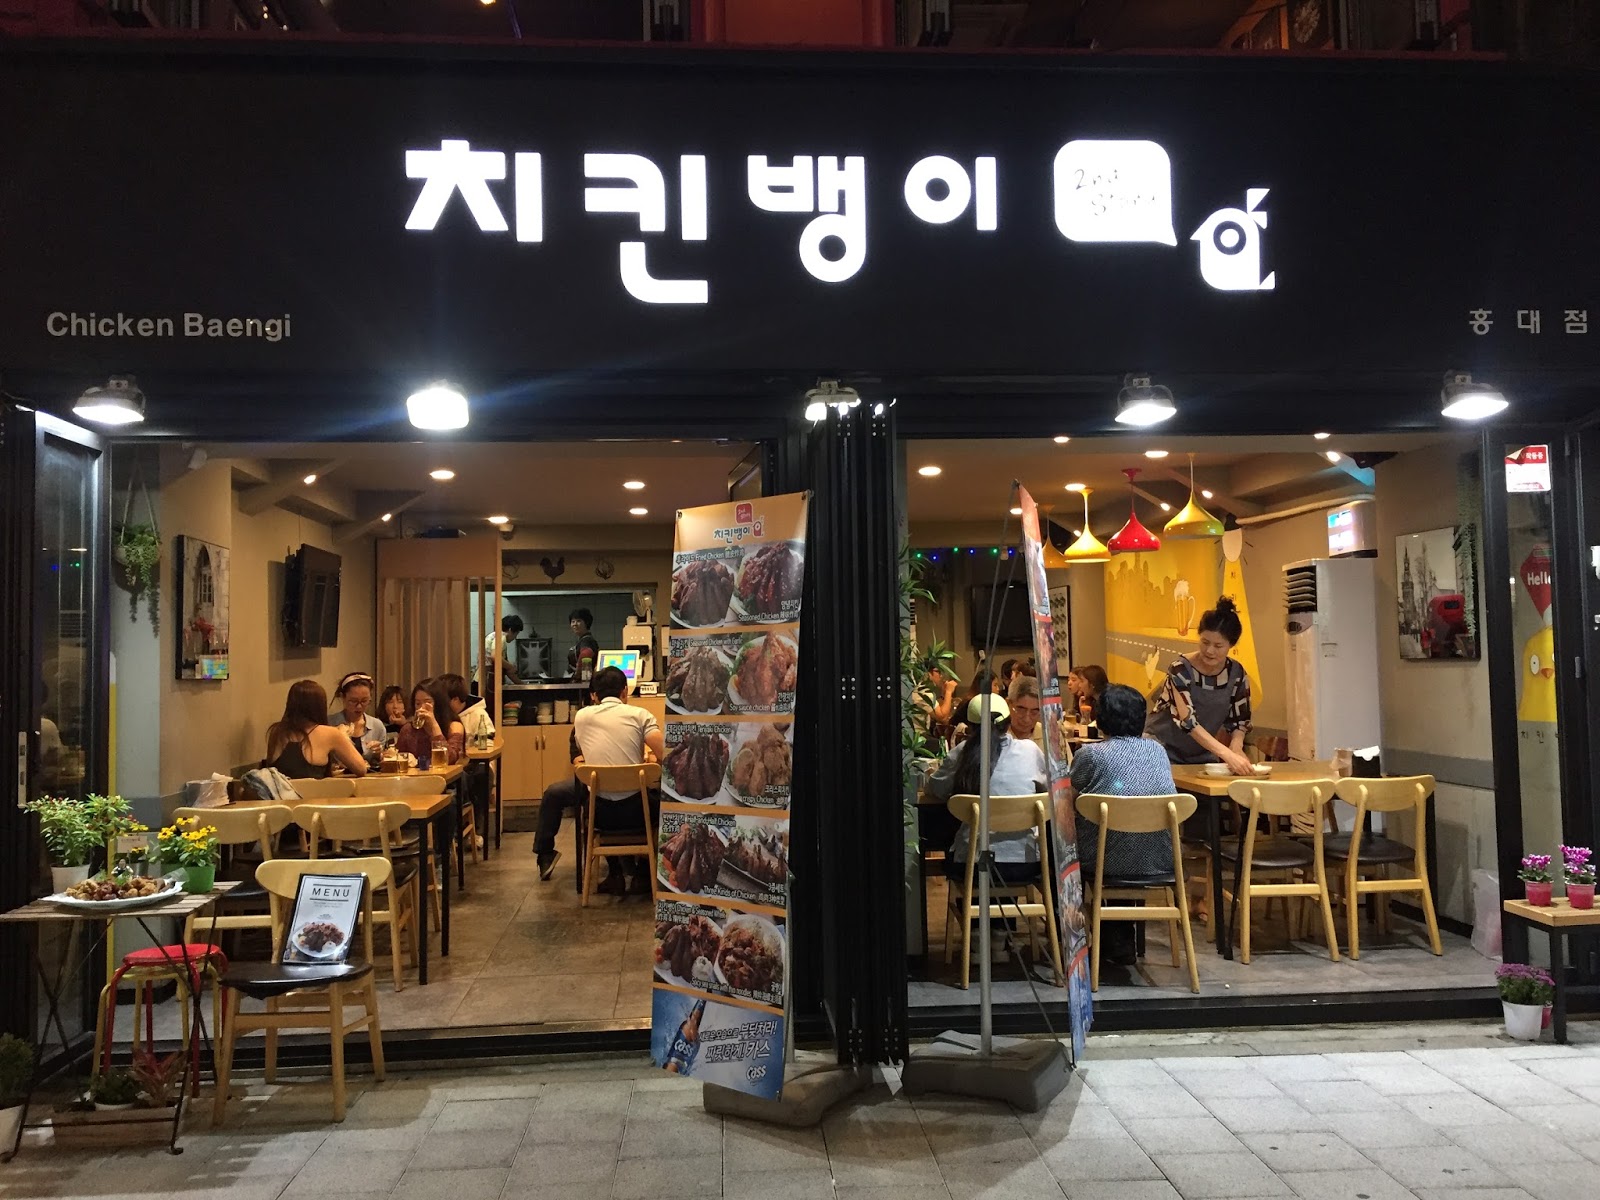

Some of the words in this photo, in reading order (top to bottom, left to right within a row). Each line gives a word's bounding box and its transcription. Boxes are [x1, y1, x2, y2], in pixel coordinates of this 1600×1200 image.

[405, 139, 998, 304] 치킨뱅이
[46, 312, 174, 337] Chicken
[183, 312, 291, 342] Baengi
[714, 527, 750, 544] 치킨뱅이
[707, 551, 725, 560] Chicken
[761, 612, 779, 620] Chicken
[312, 888, 350, 897] MENU
[746, 1040, 770, 1060] 카스
